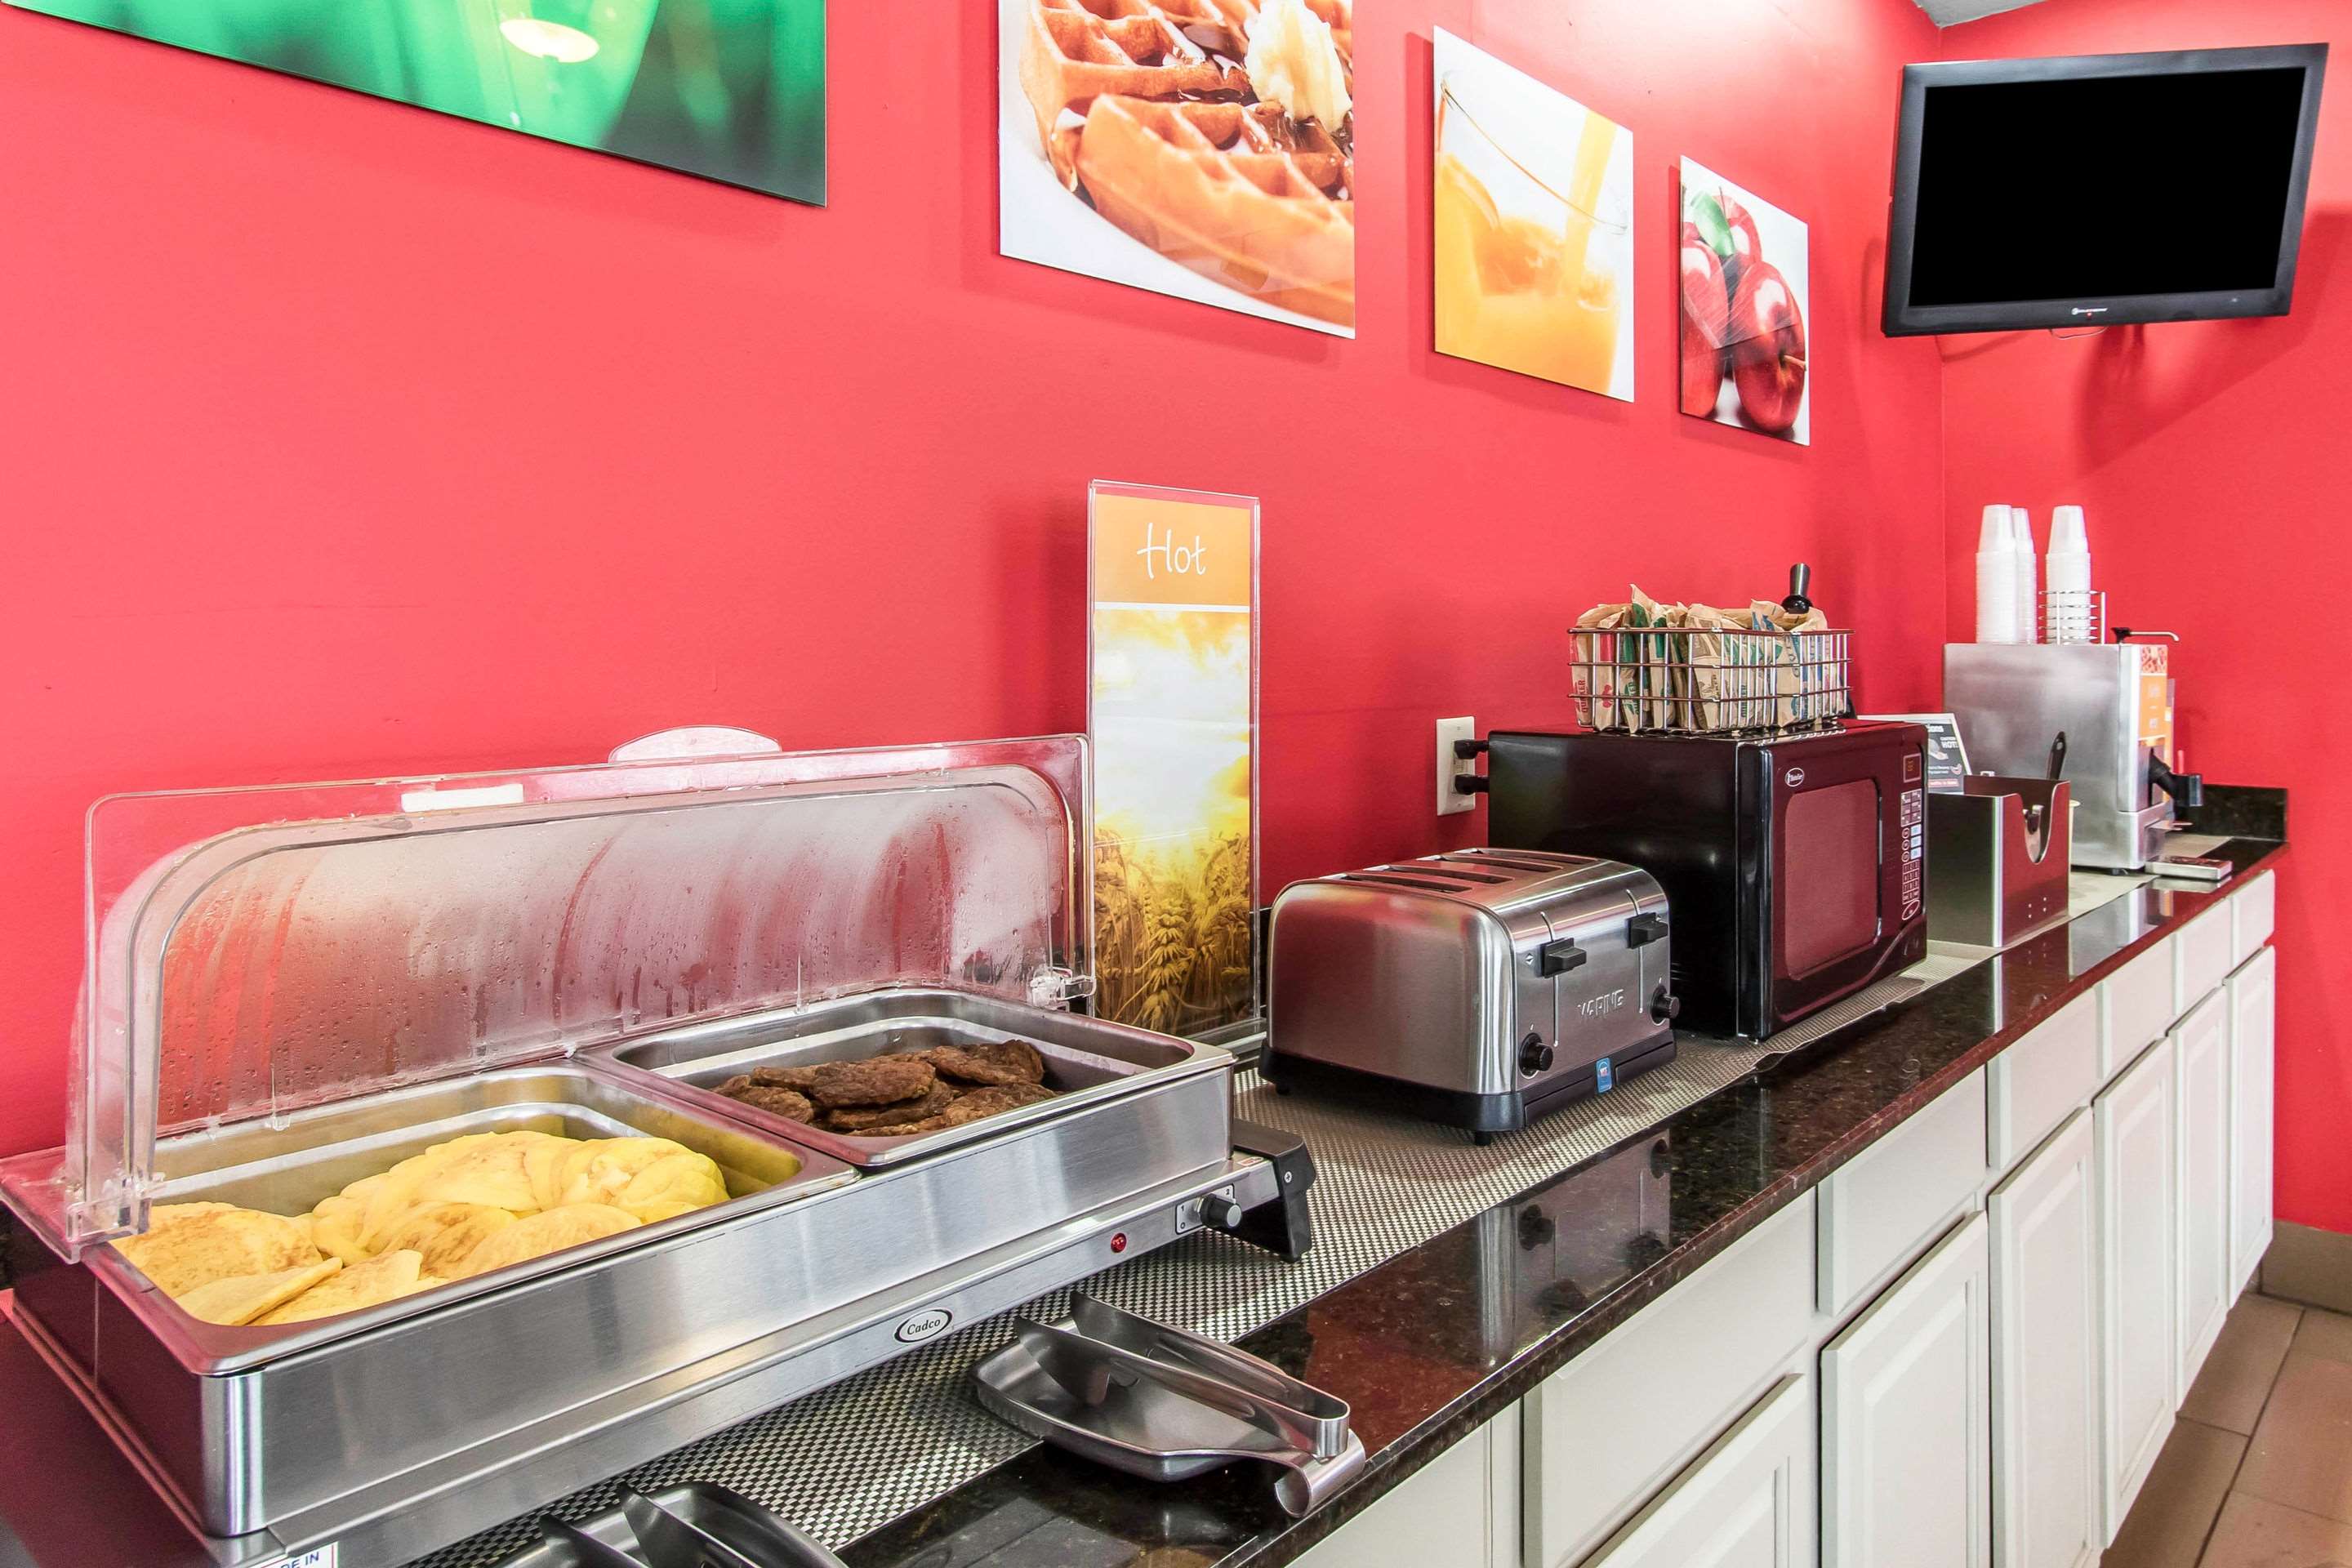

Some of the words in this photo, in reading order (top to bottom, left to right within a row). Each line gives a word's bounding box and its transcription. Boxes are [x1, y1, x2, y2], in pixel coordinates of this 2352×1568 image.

[1136, 522, 1207, 579] Hot
[906, 1319, 941, 1335] Cadco
[305, 1551, 319, 1566] IN
